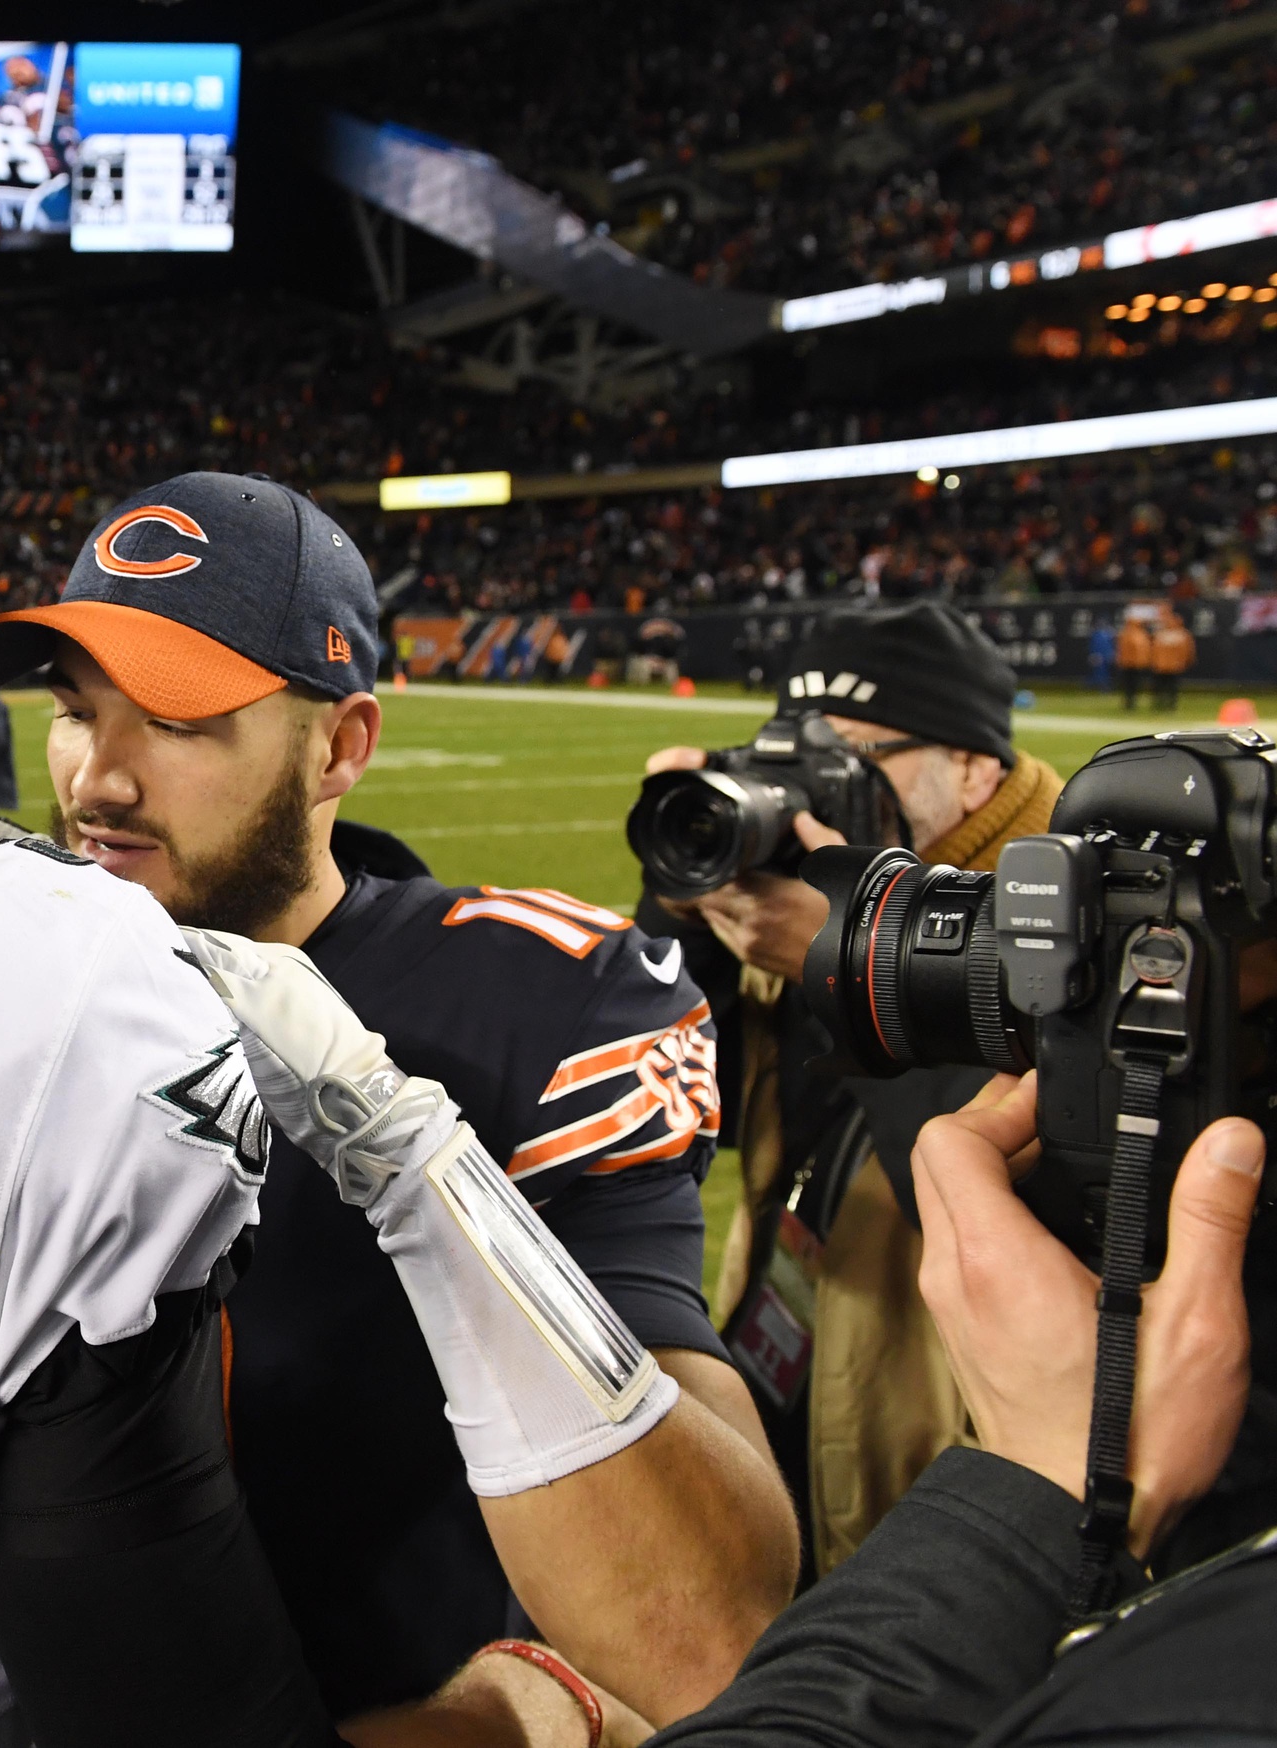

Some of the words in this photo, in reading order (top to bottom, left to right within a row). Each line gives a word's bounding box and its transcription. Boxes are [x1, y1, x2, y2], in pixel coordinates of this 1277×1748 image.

[87, 81, 194, 107] UNITED
[93, 505, 210, 579] C
[860, 900, 875, 928] CANON
[870, 876, 889, 898] FISHEYE
[1005, 881, 1059, 896] Canon
